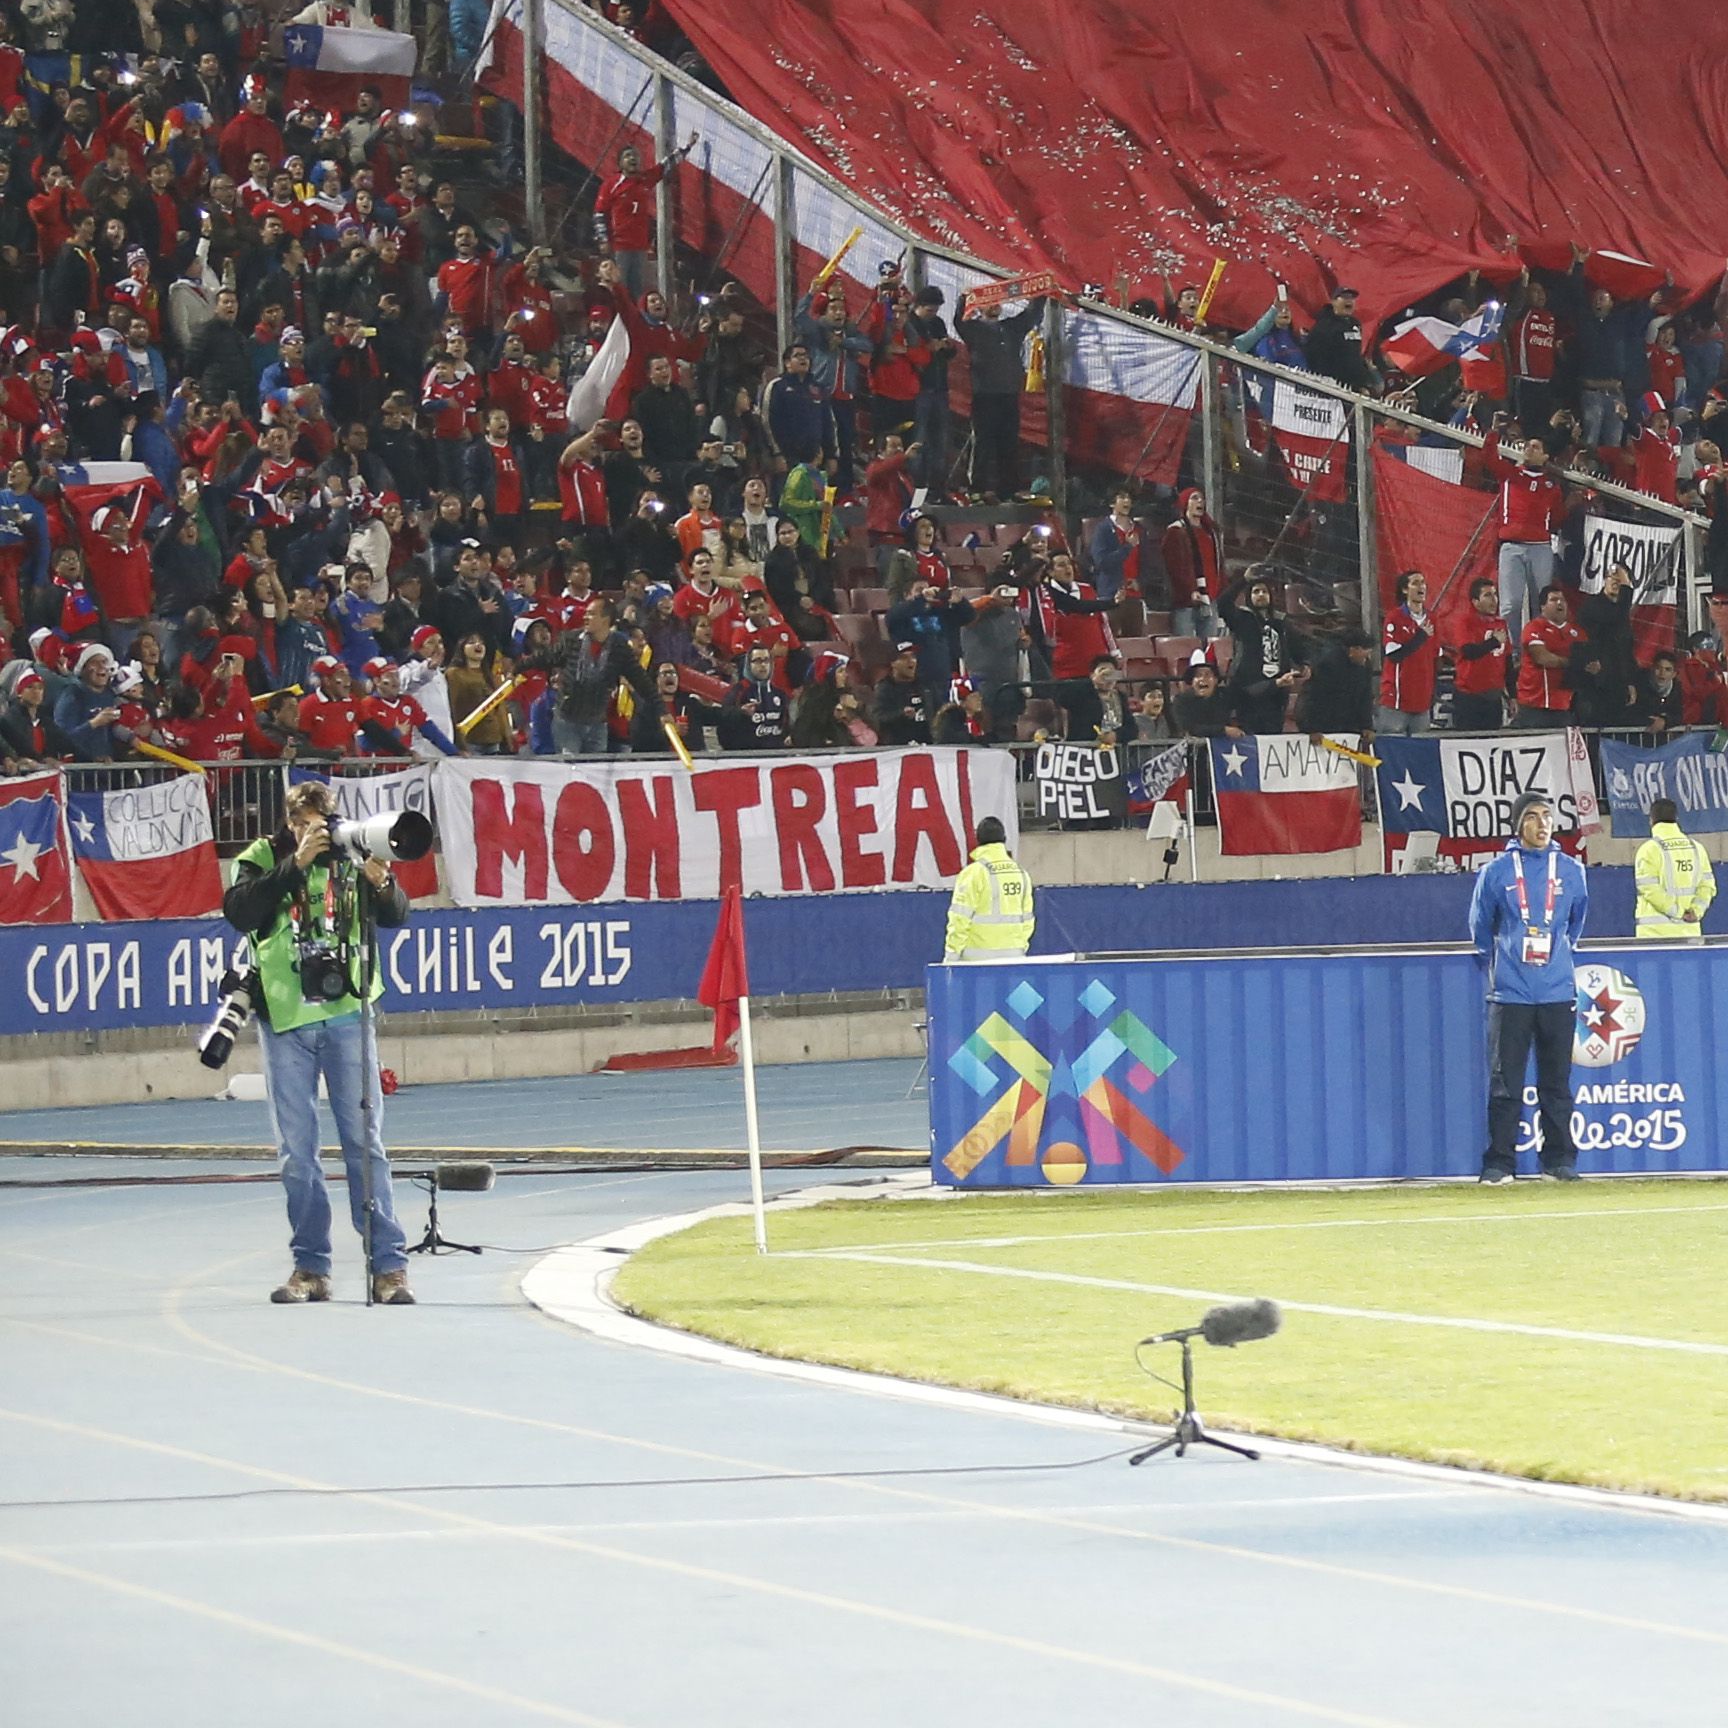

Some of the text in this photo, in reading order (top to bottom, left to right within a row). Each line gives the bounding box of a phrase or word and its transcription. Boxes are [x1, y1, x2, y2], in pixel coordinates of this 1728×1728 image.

[1457, 744, 1549, 797] DÍAZ
[1675, 754, 1709, 813] ON
[1002, 881, 1022, 896] 939
[1674, 858, 1695, 874] 785
[26, 939, 142, 1014] COPA
[540, 920, 633, 988] 2015
[1574, 1078, 1686, 1106] AMÉRICA
[1609, 1108, 1688, 1152] 2015
